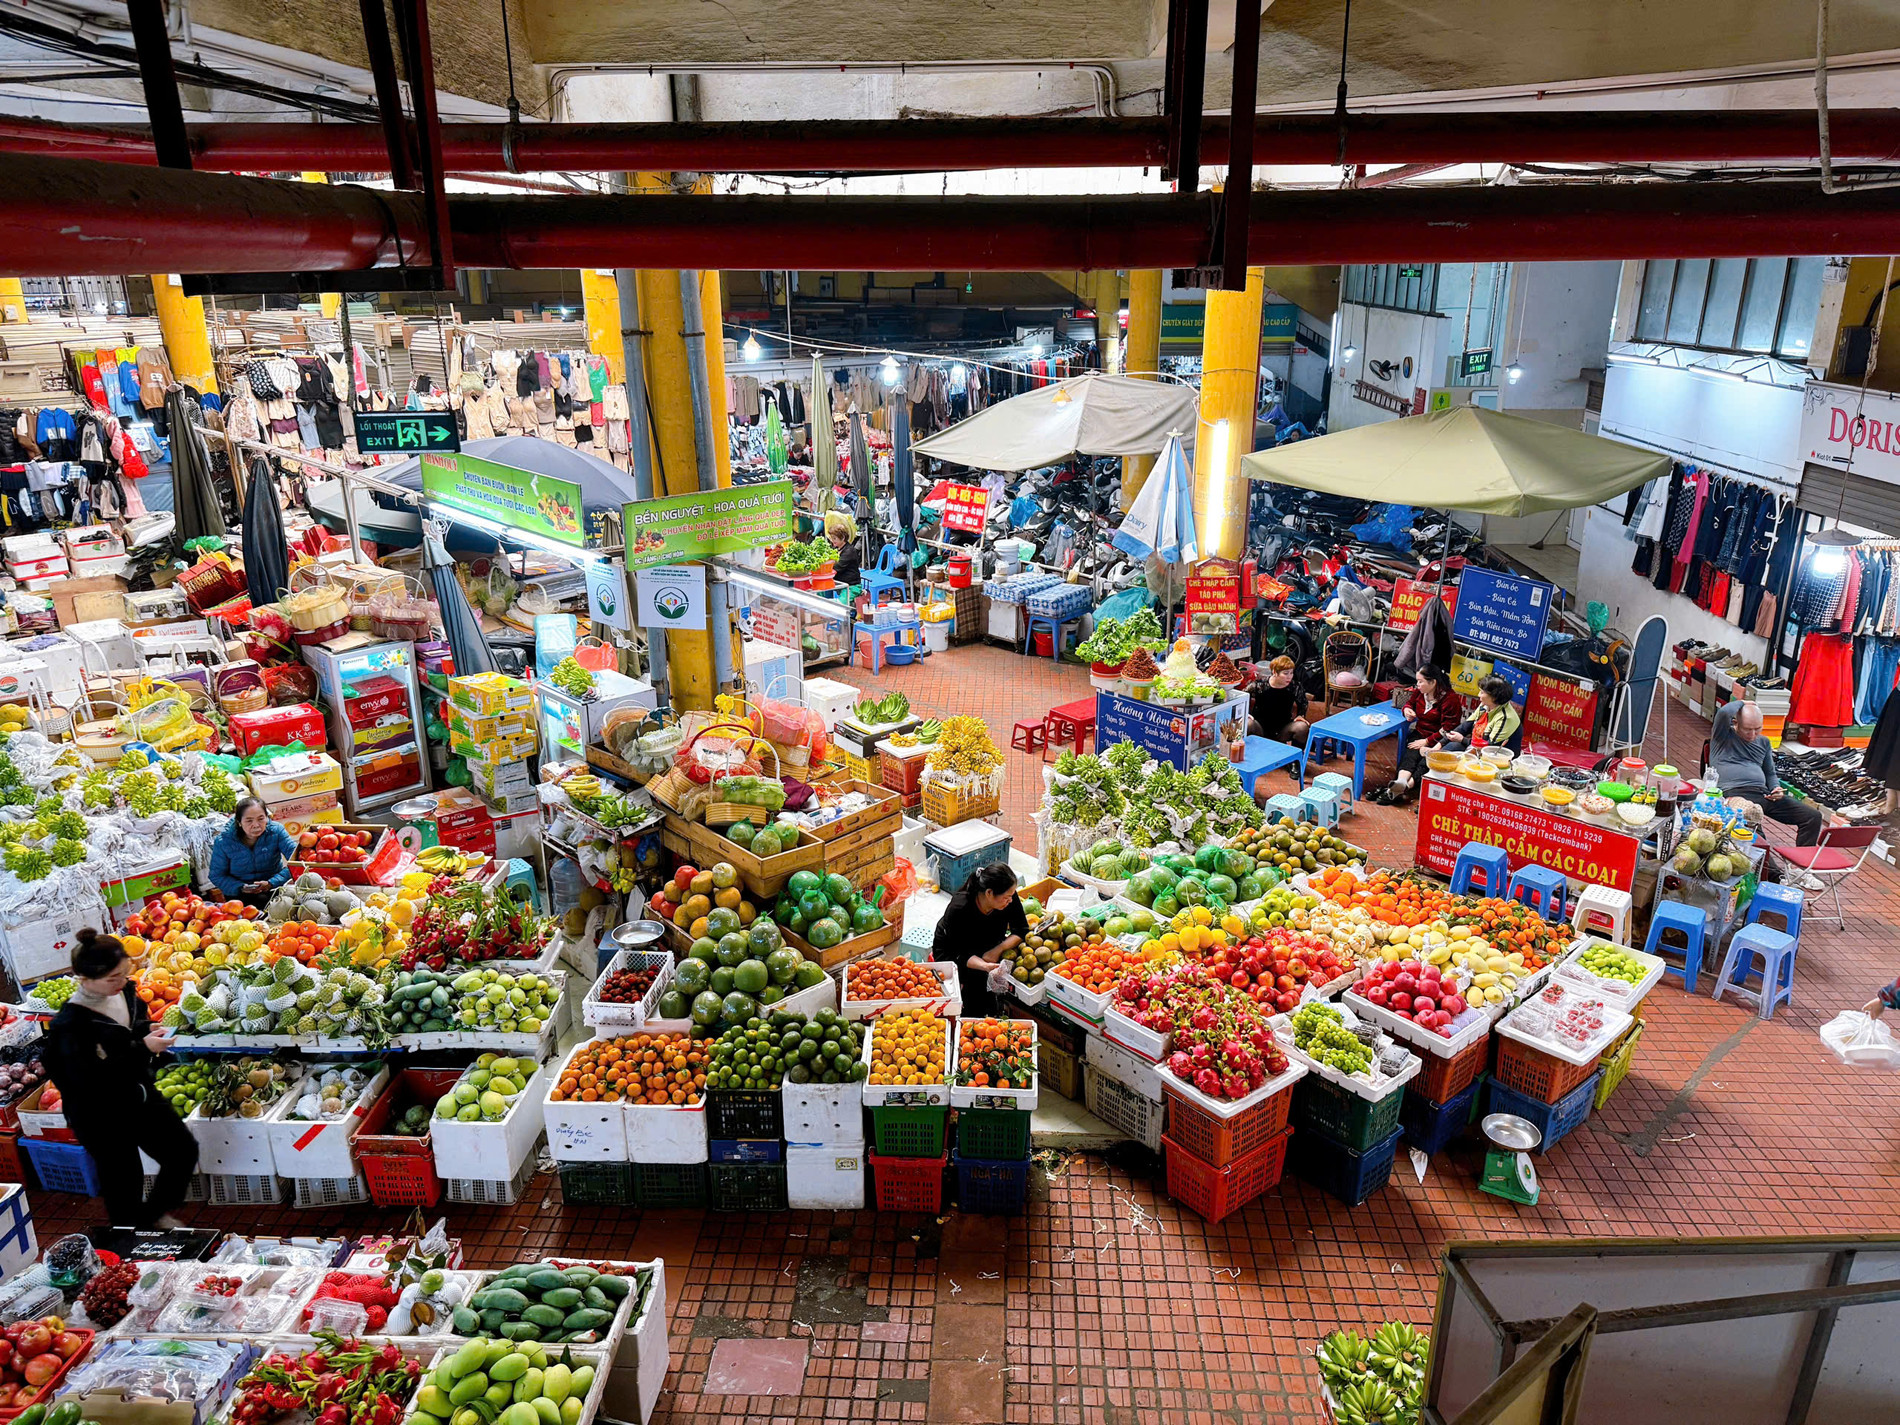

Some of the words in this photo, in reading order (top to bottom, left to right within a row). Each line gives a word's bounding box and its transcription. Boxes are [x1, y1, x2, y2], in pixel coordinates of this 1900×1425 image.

[1469, 353, 1488, 364] EXIT
[360, 420, 371, 431] LỐI
[373, 421, 396, 431] THOÁT
[366, 437, 394, 446] EXIT
[661, 504, 706, 521] NGUYỆT
[713, 502, 737, 514] HOA
[738, 497, 761, 508] QUẢ
[761, 492, 785, 503] TƯƠI
[1127, 513, 1148, 531] Dairy
[661, 523, 694, 536] CHUYÊN
[1496, 579, 1510, 590] Bún
[1398, 593, 1423, 608] ĐẶC
[1492, 593, 1506, 604] Bún
[1507, 595, 1517, 606] Cá
[1390, 606, 1404, 619] SỮA
[1469, 601, 1482, 612] Bún
[1471, 616, 1485, 627] Bún
[1479, 631, 1491, 641] 091
[1504, 636, 1520, 650] 7473
[1457, 670, 1474, 683] 60
[360, 699, 381, 710] envy
[1527, 709, 1550, 727] BÁNH
[1570, 725, 1590, 741] LỌC
[303, 729, 321, 738] Apple
[373, 773, 391, 784] envy
[1457, 805, 1473, 817] STK:
[1489, 803, 1501, 814] ĐT:
[1501, 806, 1523, 821] 09166
[1523, 813, 1547, 827] 27473
[1553, 822, 1572, 834] 0926
[1573, 828, 1582, 838] 11
[1583, 831, 1603, 844] 5239
[1431, 814, 1461, 835] CHÈ
[1463, 822, 1504, 849] THẬP
[1505, 833, 1540, 861] CẨM
[1541, 846, 1575, 871] CÁC
[1576, 858, 1618, 886] LOẠI
[1428, 854, 1449, 867] THẠCH
